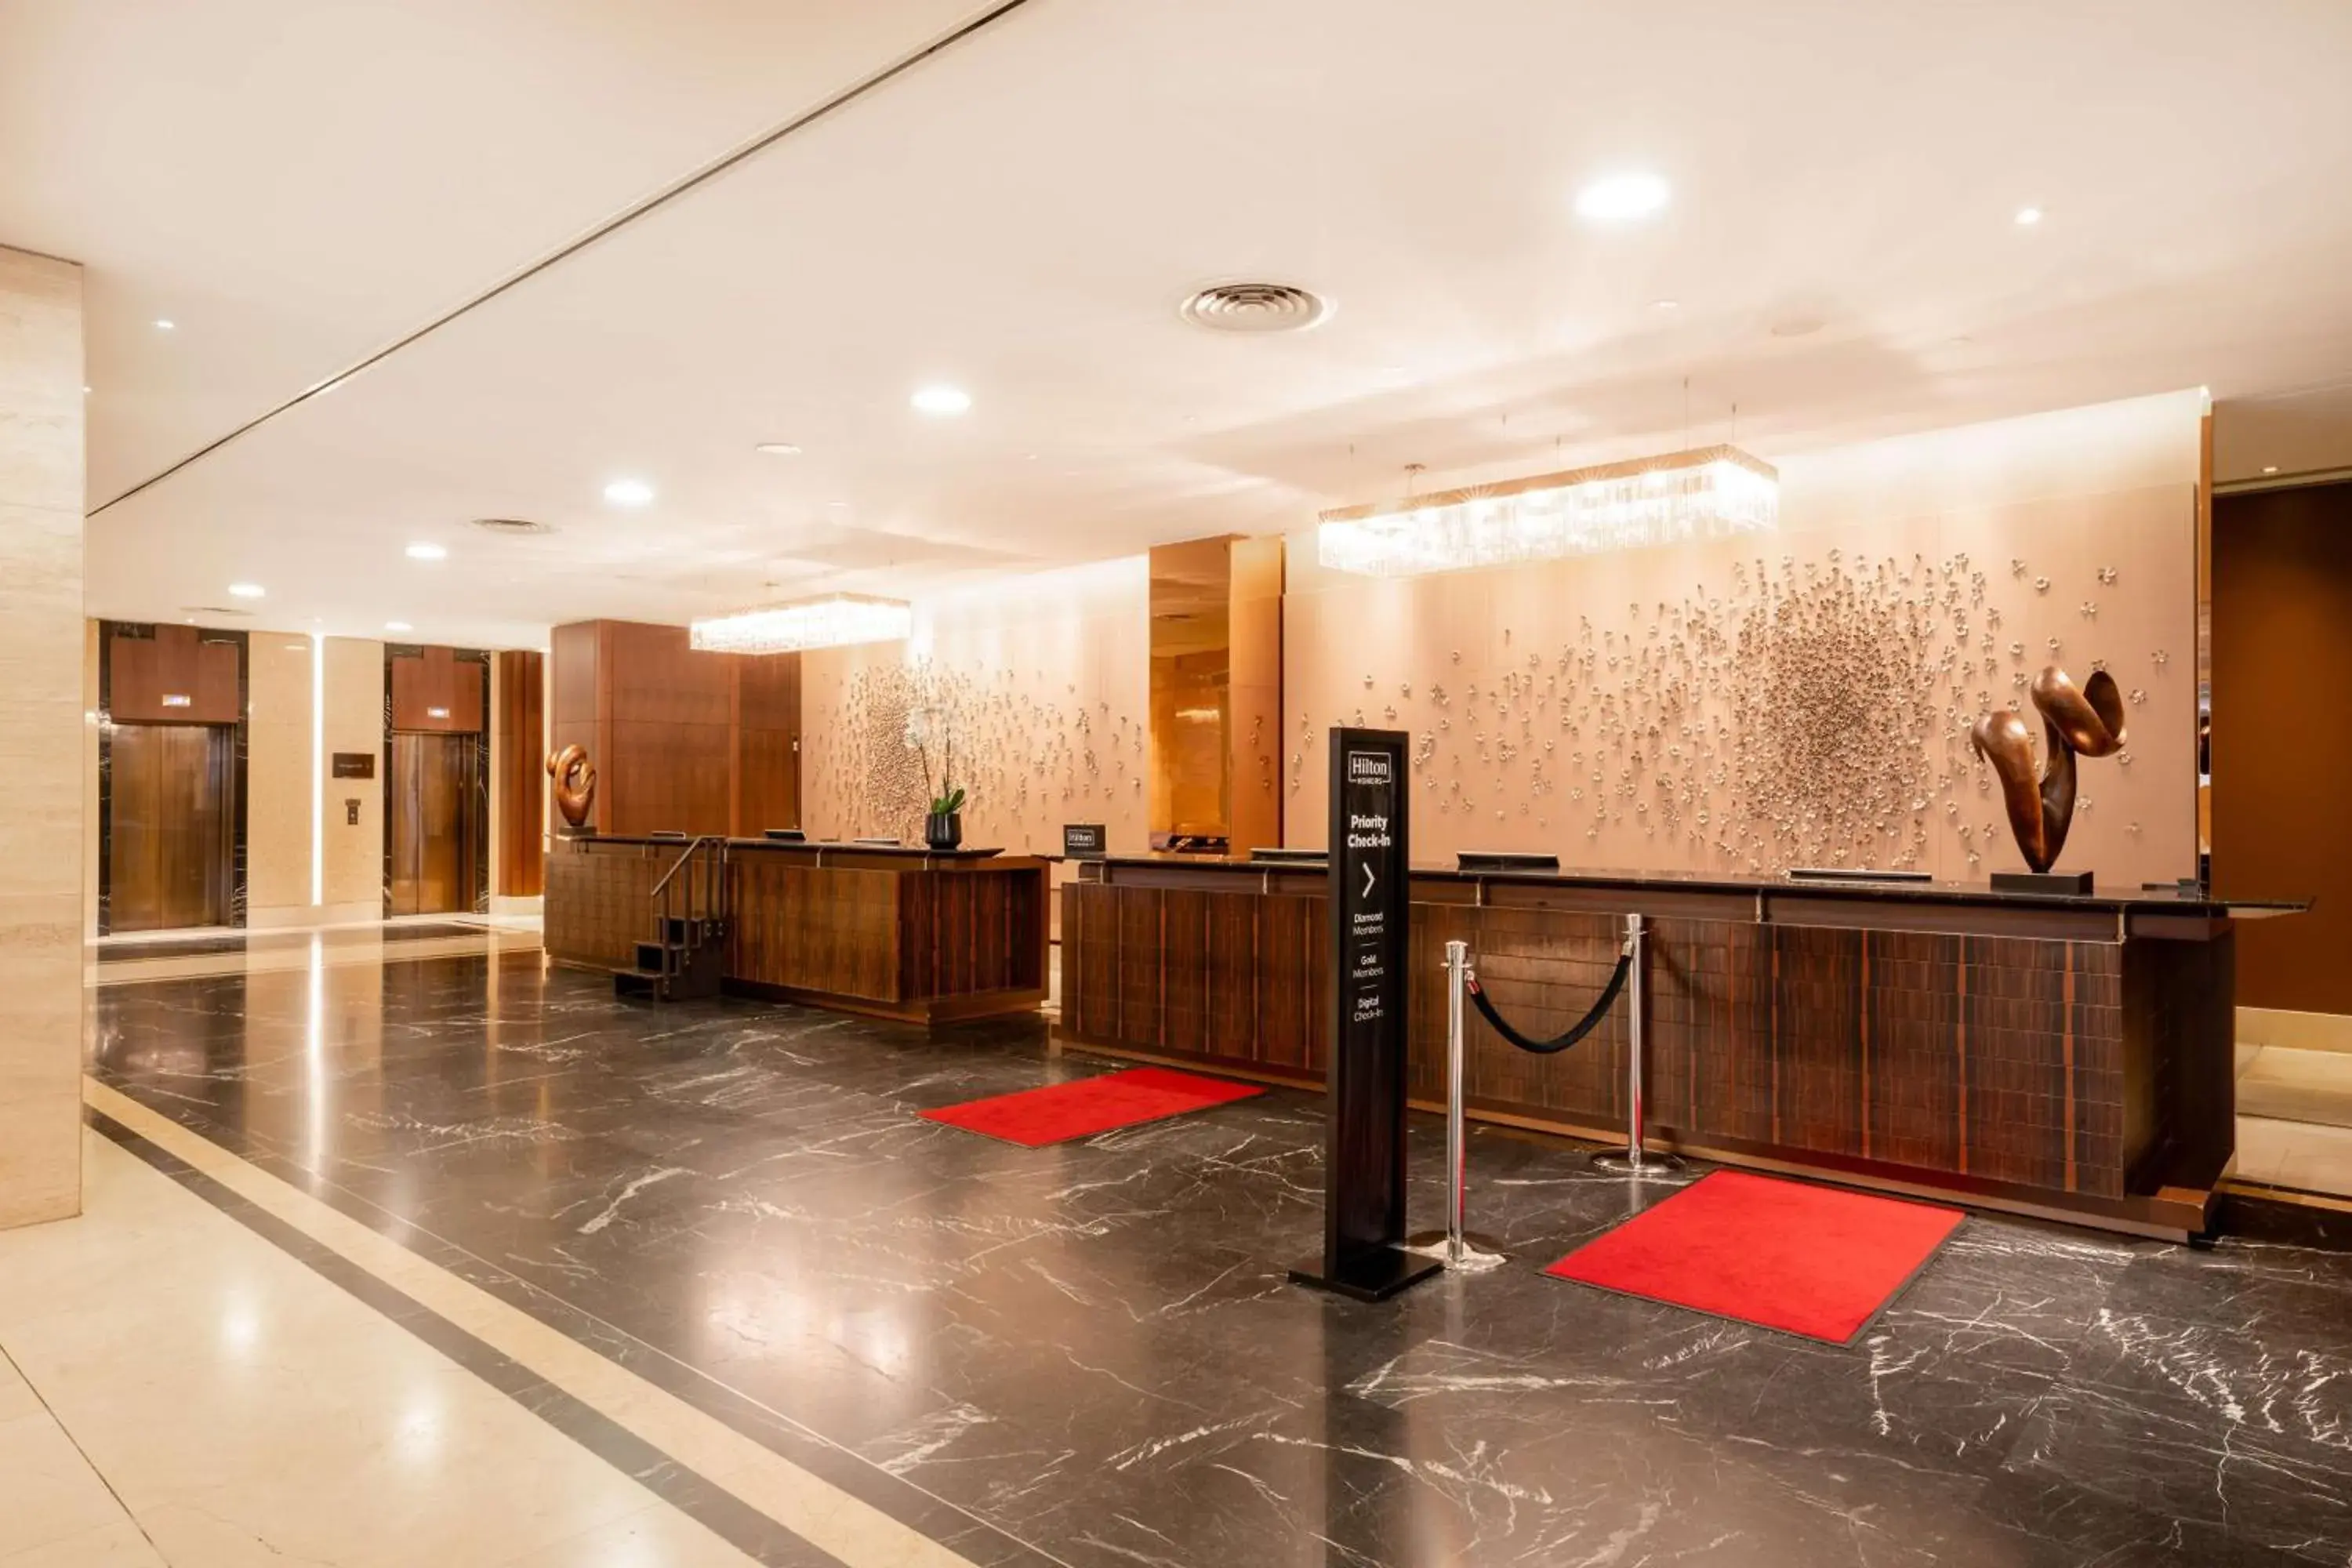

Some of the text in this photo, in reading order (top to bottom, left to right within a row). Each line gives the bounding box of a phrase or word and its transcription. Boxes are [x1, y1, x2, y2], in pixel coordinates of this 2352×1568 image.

[1352, 757, 1388, 775] Hilton
[1351, 815, 1388, 831] Priority
[1354, 911, 1383, 924] Diamond
[1352, 925, 1384, 936] Members
[1360, 954, 1377, 966] Gold
[1352, 967, 1384, 979] Members
[1358, 994, 1379, 1010] Digital
